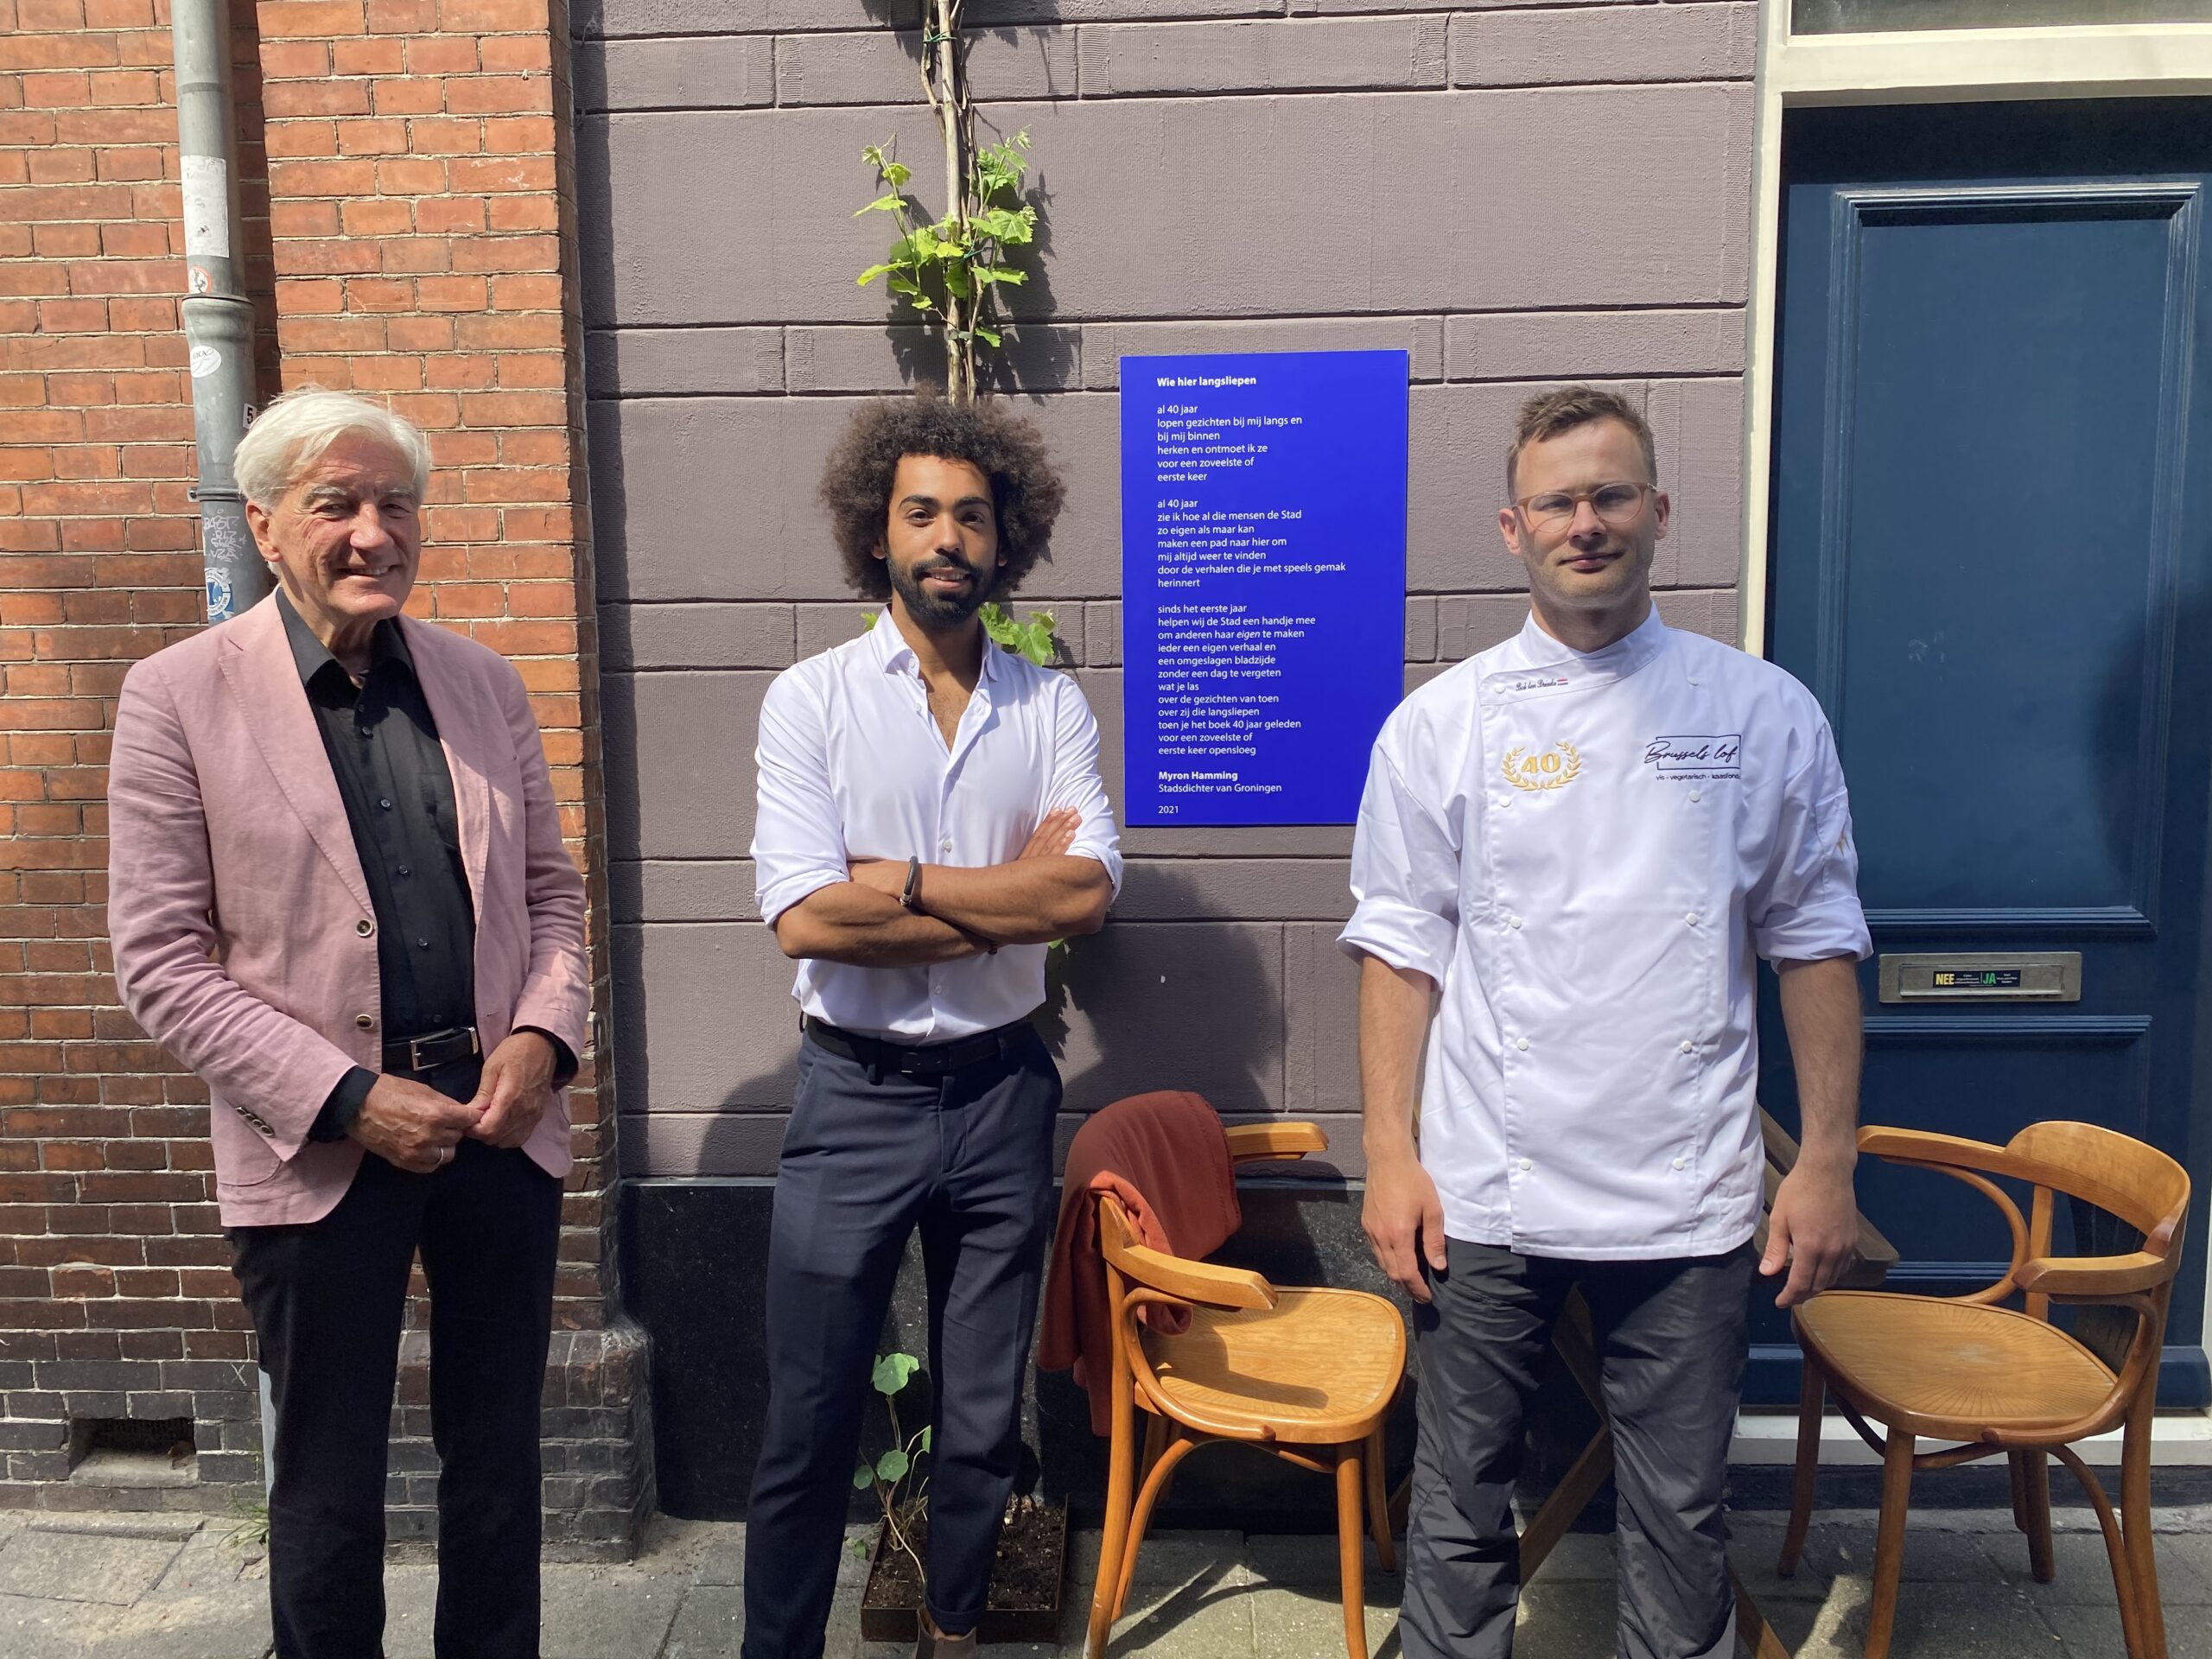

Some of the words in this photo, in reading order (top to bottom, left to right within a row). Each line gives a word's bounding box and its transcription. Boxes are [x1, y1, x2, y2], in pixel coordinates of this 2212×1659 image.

[1156, 377, 1175, 387] Wie
[1177, 376, 1198, 386] hier
[1198, 375, 1256, 388] langsliepen
[247, 407, 253, 424] 5
[1156, 404, 1165, 414] al
[1166, 404, 1179, 414] 40
[1179, 404, 1198, 416] jaar
[1157, 417, 1184, 429] lopen
[1185, 416, 1230, 429] gezichten
[1233, 416, 1244, 428] bij
[1247, 416, 1262, 427] mij
[1263, 416, 1288, 427] langs
[1157, 431, 1168, 443] bij
[1171, 431, 1185, 442] mij
[1187, 430, 1220, 441] binnen
[1157, 444, 1189, 454] herken
[1205, 444, 1245, 454] ontmoet
[1247, 442, 1255, 452] ik
[1157, 460, 1179, 468] voor
[1199, 456, 1243, 467] zoveelste
[1244, 456, 1255, 466] of
[1157, 473, 1185, 481] eerste
[1187, 471, 1207, 480] keer
[1157, 499, 1165, 508] al
[1166, 499, 1179, 508] 40
[1180, 499, 1198, 510] jaar
[1157, 512, 1170, 521] zie
[1172, 512, 1180, 521] ik
[1182, 512, 1199, 521] hoe
[1201, 511, 1210, 520] al
[1211, 511, 1226, 520] die
[1267, 510, 1279, 519] de
[1281, 510, 1301, 518] Stad
[1170, 525, 1196, 537] eigen
[1198, 524, 1210, 534] als
[1237, 524, 1254, 533] kan
[1158, 538, 1188, 548] maken
[1210, 537, 1227, 549] pad
[1251, 537, 1269, 546] hier
[1158, 552, 1172, 563] mij
[1173, 551, 1196, 563] altijd
[1223, 551, 1232, 560] te
[1234, 550, 1266, 559] vinden
[1157, 564, 1179, 574] door
[1181, 564, 1192, 574] de
[1194, 563, 1234, 574] verhalen
[1236, 563, 1251, 573] die
[1252, 563, 1262, 575] je
[1263, 563, 1281, 572] met
[1283, 562, 1312, 574] speels
[1313, 562, 1345, 574] gemak
[1158, 577, 1199, 587] herinnert
[1158, 604, 1180, 613] sinds
[1183, 603, 1198, 613] het
[1199, 604, 1228, 613] eerste
[1229, 603, 1247, 614] jaar
[1158, 617, 1189, 628] helpen
[1191, 617, 1205, 627] wij
[1206, 616, 1218, 626] de
[1220, 616, 1241, 626] Stad
[1262, 615, 1294, 626] handje
[1174, 629, 1212, 639] anderen
[1214, 629, 1235, 639] haar
[1236, 629, 1260, 640] eigen
[1262, 629, 1272, 638] te
[1274, 628, 1304, 638] maken
[1158, 643, 1181, 652] ieder
[1201, 643, 1227, 653] eigen
[1229, 642, 1262, 652] verhaal
[1177, 655, 1232, 667] omgeslagen
[1234, 654, 1275, 666] bladzijde
[1158, 669, 1189, 677] zonder
[1210, 668, 1227, 679] dag
[1241, 669, 1281, 679] vergeten
[1176, 682, 1185, 692] je
[1187, 681, 1199, 690] las
[1179, 694, 1192, 703] de
[1193, 694, 1237, 705] gezichten
[1179, 708, 1189, 718] zij
[1192, 707, 1206, 715] die
[1208, 707, 1259, 717] langsliepen
[1180, 720, 1189, 731] je
[1191, 720, 1206, 728] het
[1208, 720, 1230, 728] boek
[1232, 720, 1243, 728] 40
[1245, 720, 1262, 730] jaar
[1264, 719, 1301, 730] geleden
[1199, 732, 1241, 741] zoveelste
[1243, 732, 1253, 741] of
[1187, 745, 1207, 754] keer
[1208, 745, 1255, 756] opensloeg
[1643, 741, 1711, 763] Brussels
[1713, 744, 1738, 763] lof
[1521, 752, 1560, 775] 40
[1158, 771, 1189, 782] Myron
[1191, 770, 1237, 782] Hamming
[1158, 783, 1214, 792] Stadsdichter
[1234, 783, 1281, 794] Groningen
[1158, 805, 1179, 814] 2021
[1936, 973, 1955, 985] NEE
[1983, 973, 1996, 984] JA
